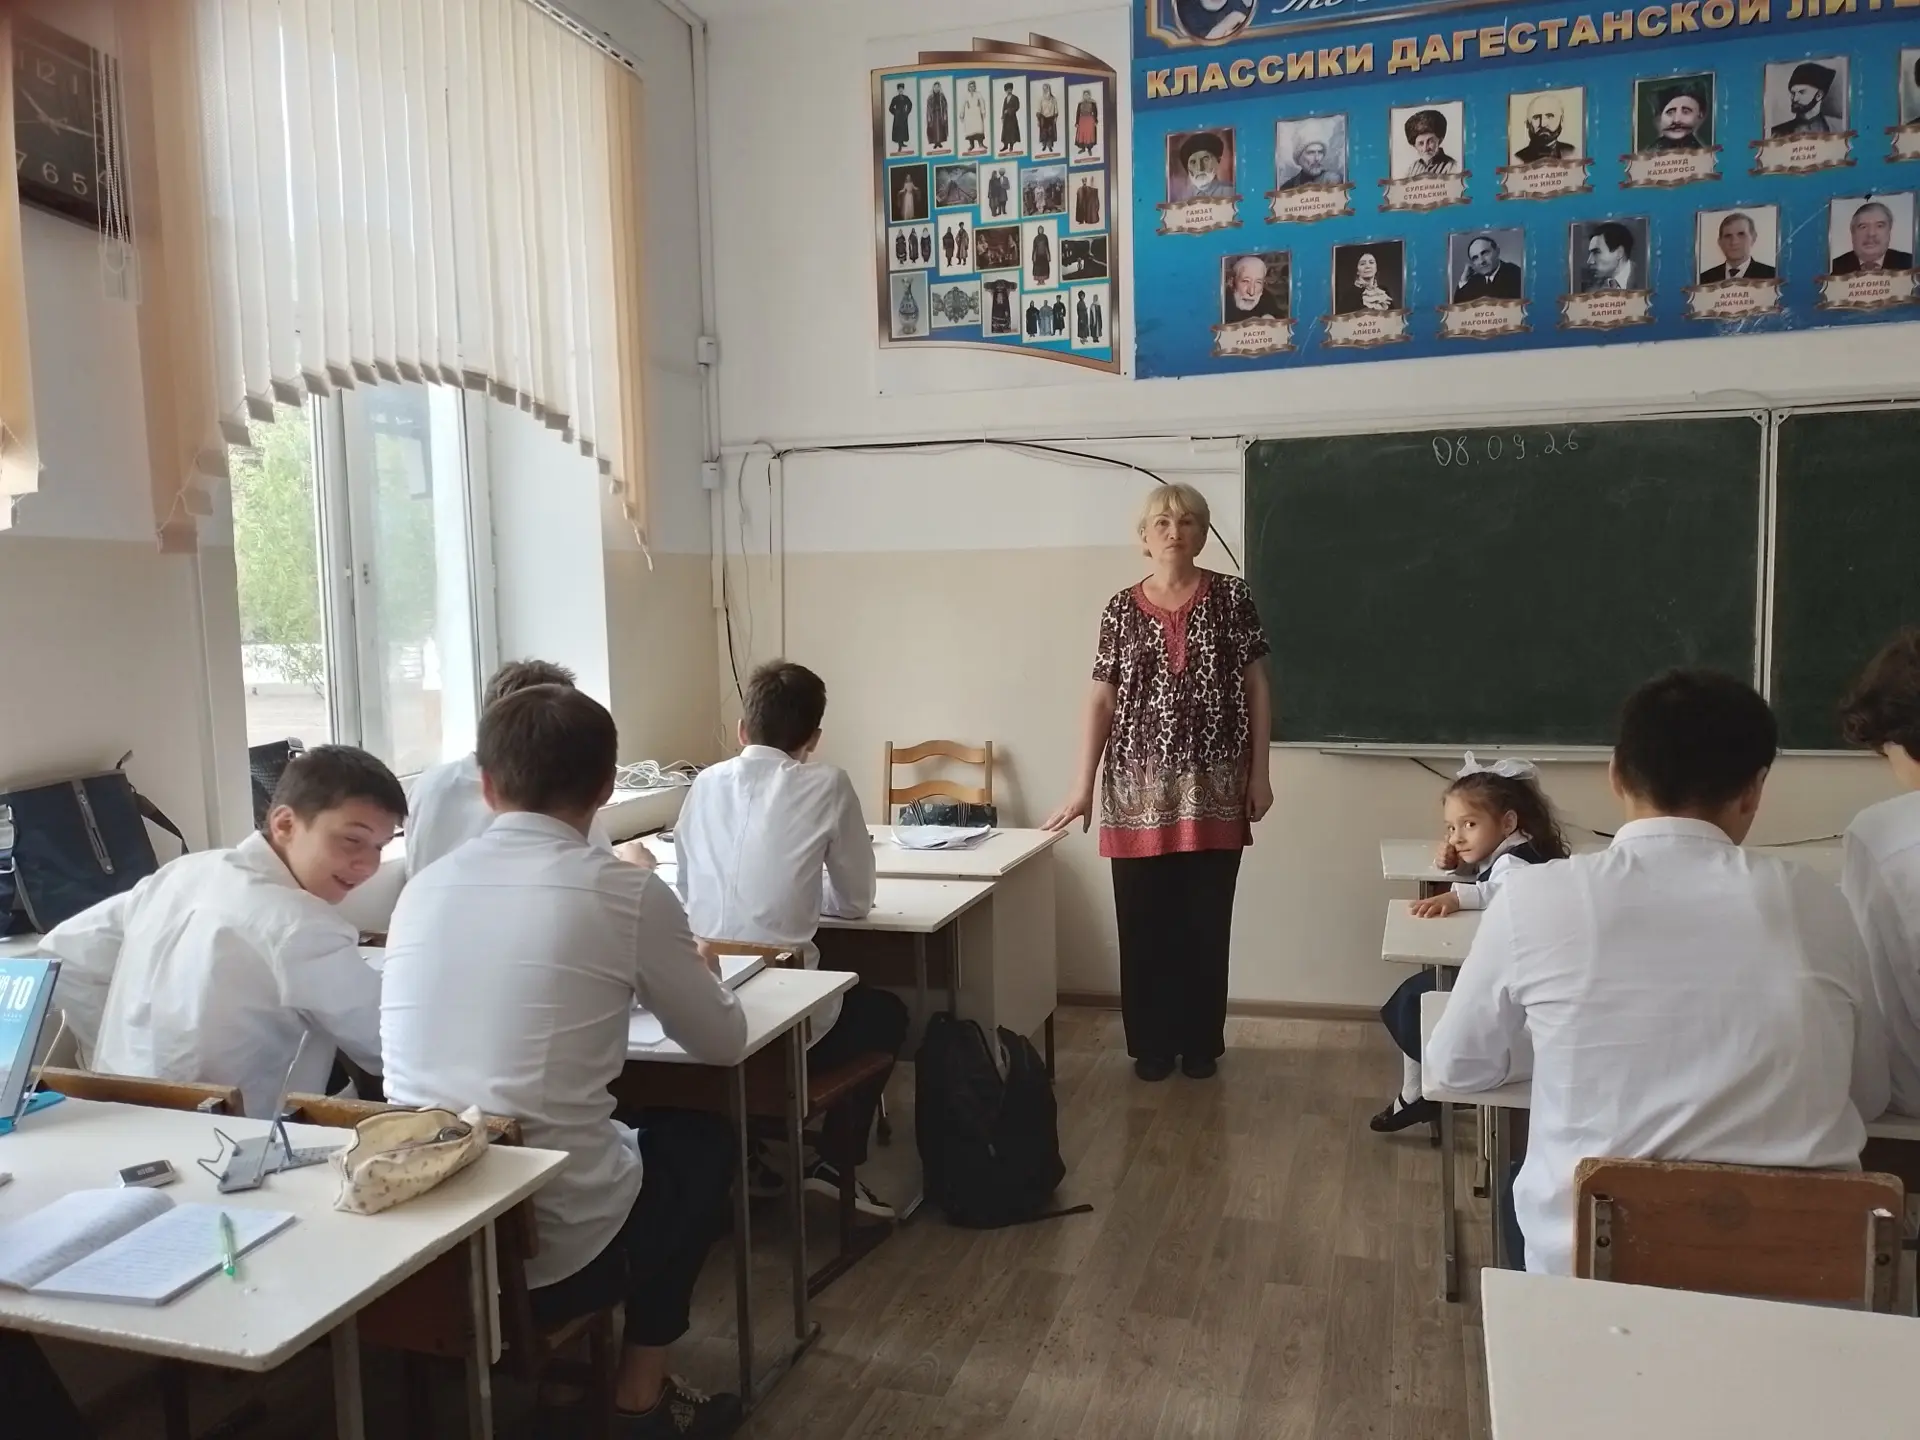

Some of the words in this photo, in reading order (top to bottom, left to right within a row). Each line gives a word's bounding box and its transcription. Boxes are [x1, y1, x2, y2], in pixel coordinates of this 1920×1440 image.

[36, 57, 56, 85] 12
[1146, 43, 1374, 99] КЛАССИКИ
[1654, 158, 1689, 167] МАХМУД
[42, 162, 59, 184] 6
[1523, 171, 1569, 180] АЛИ-ГАДЖИ
[72, 172, 87, 195] 5
[1540, 179, 1562, 187] ИНХО
[1405, 183, 1446, 193] СУЛЕЙМАН
[1403, 191, 1448, 200] СТАЛЬСКИЙ
[1848, 280, 1891, 289] МАГОМЕД
[1720, 291, 1749, 299] АХМАД
[1848, 288, 1890, 297] АХМЕДОВ
[1588, 301, 1626, 309] ЭФФЕНДИ
[1714, 299, 1755, 308] ДЖАЧАЕВ
[1591, 309, 1623, 317] КАПИЕВ
[1236, 337, 1273, 345] ГАМЗАТОВ
[7, 976, 35, 1010] 10
